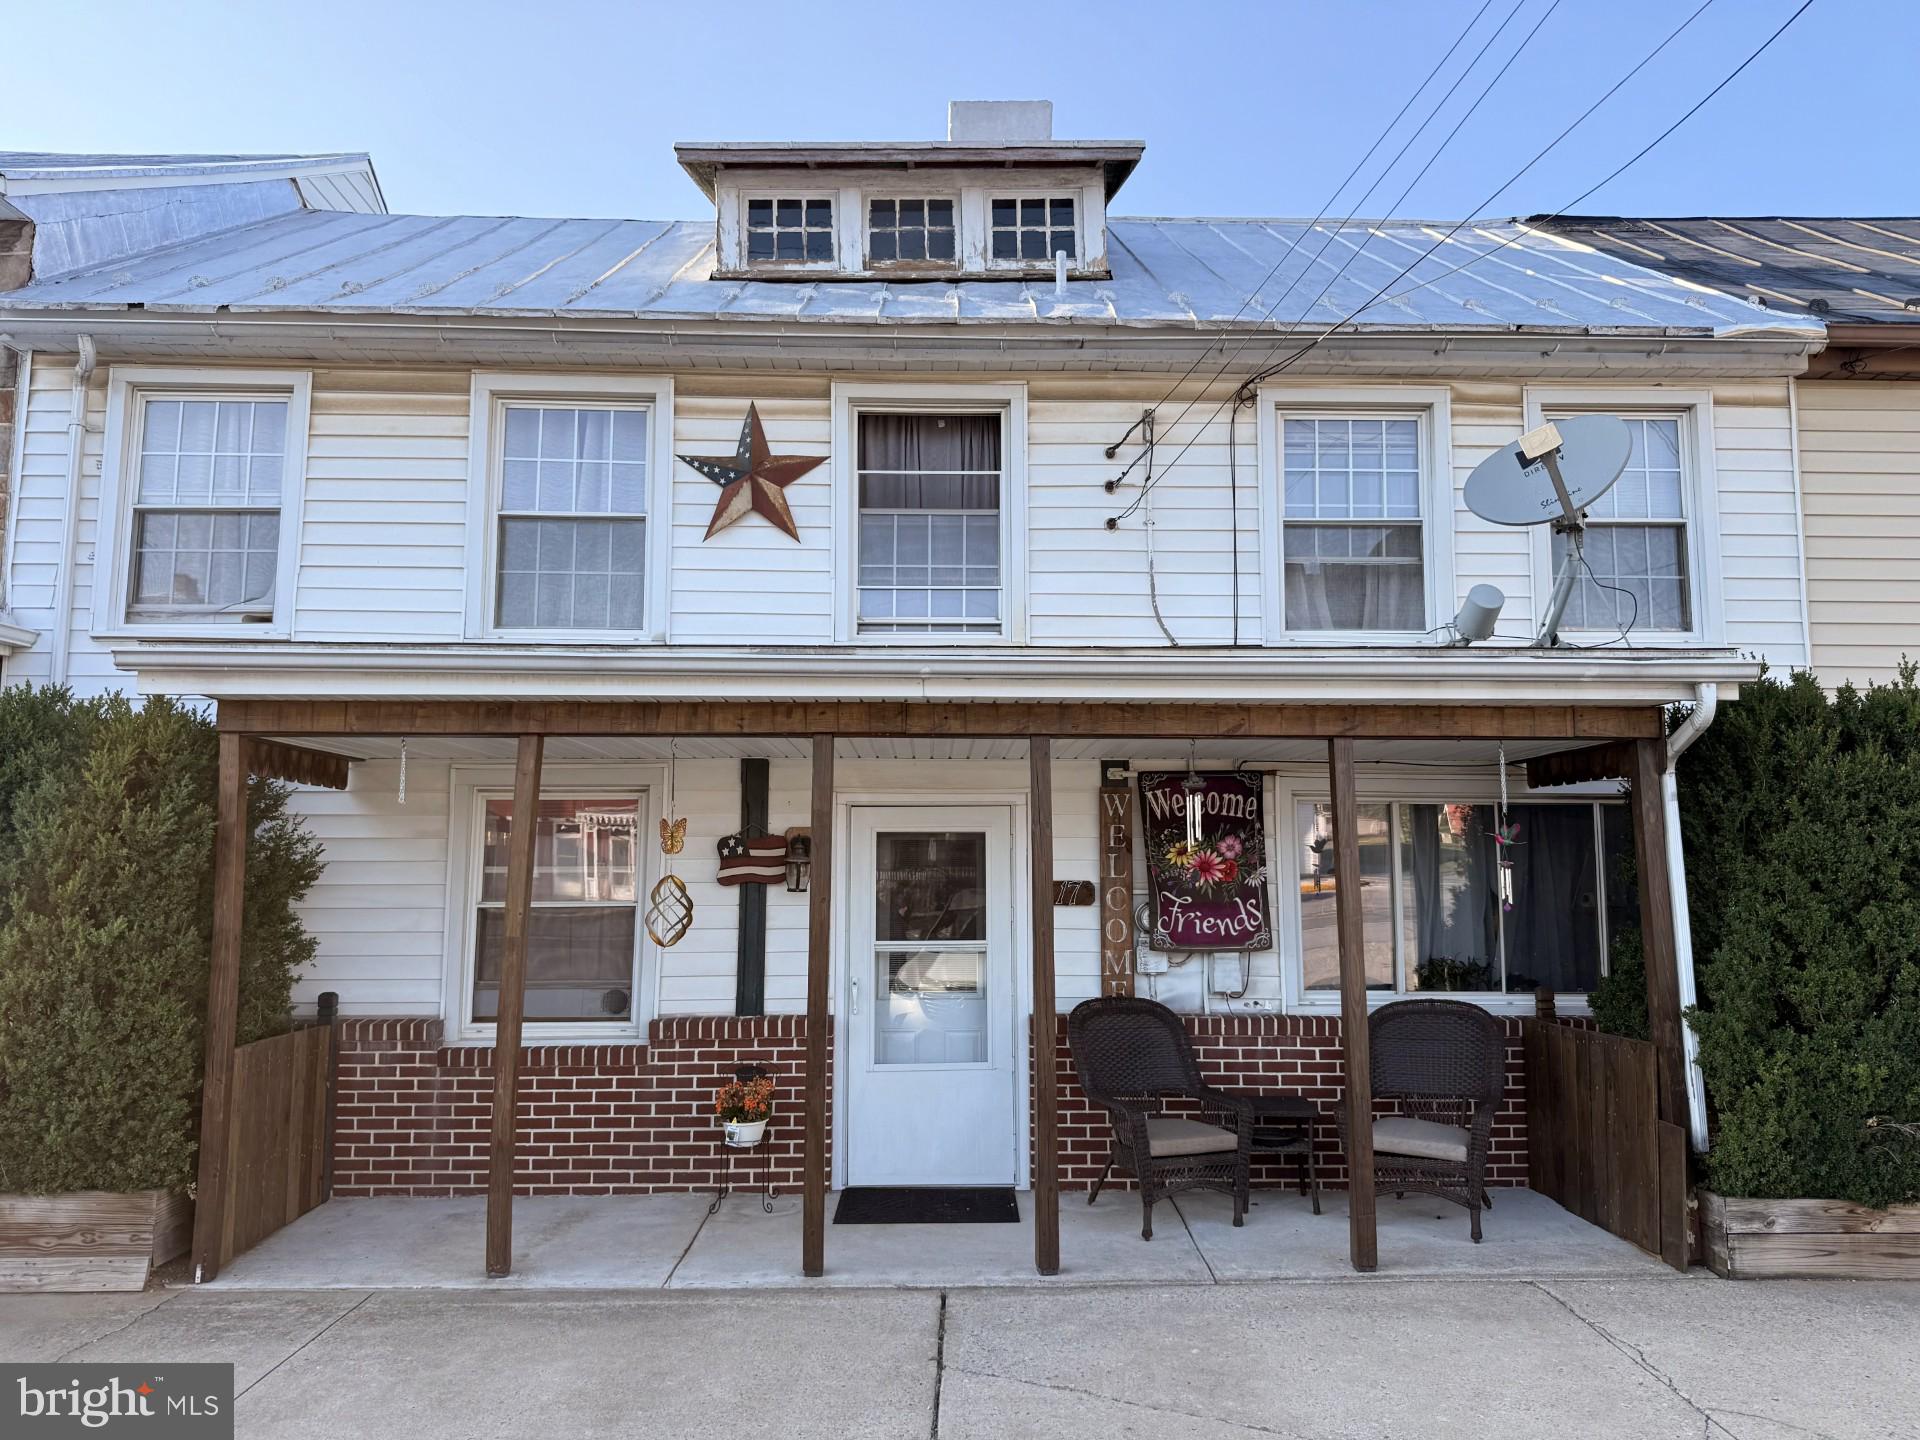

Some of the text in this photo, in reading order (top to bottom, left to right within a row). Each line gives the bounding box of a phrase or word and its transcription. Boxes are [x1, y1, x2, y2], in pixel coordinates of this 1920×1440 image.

[1524, 454, 1564, 478] DIREV
[1055, 880, 1083, 906] 17
[1157, 891, 1262, 937] Friends
